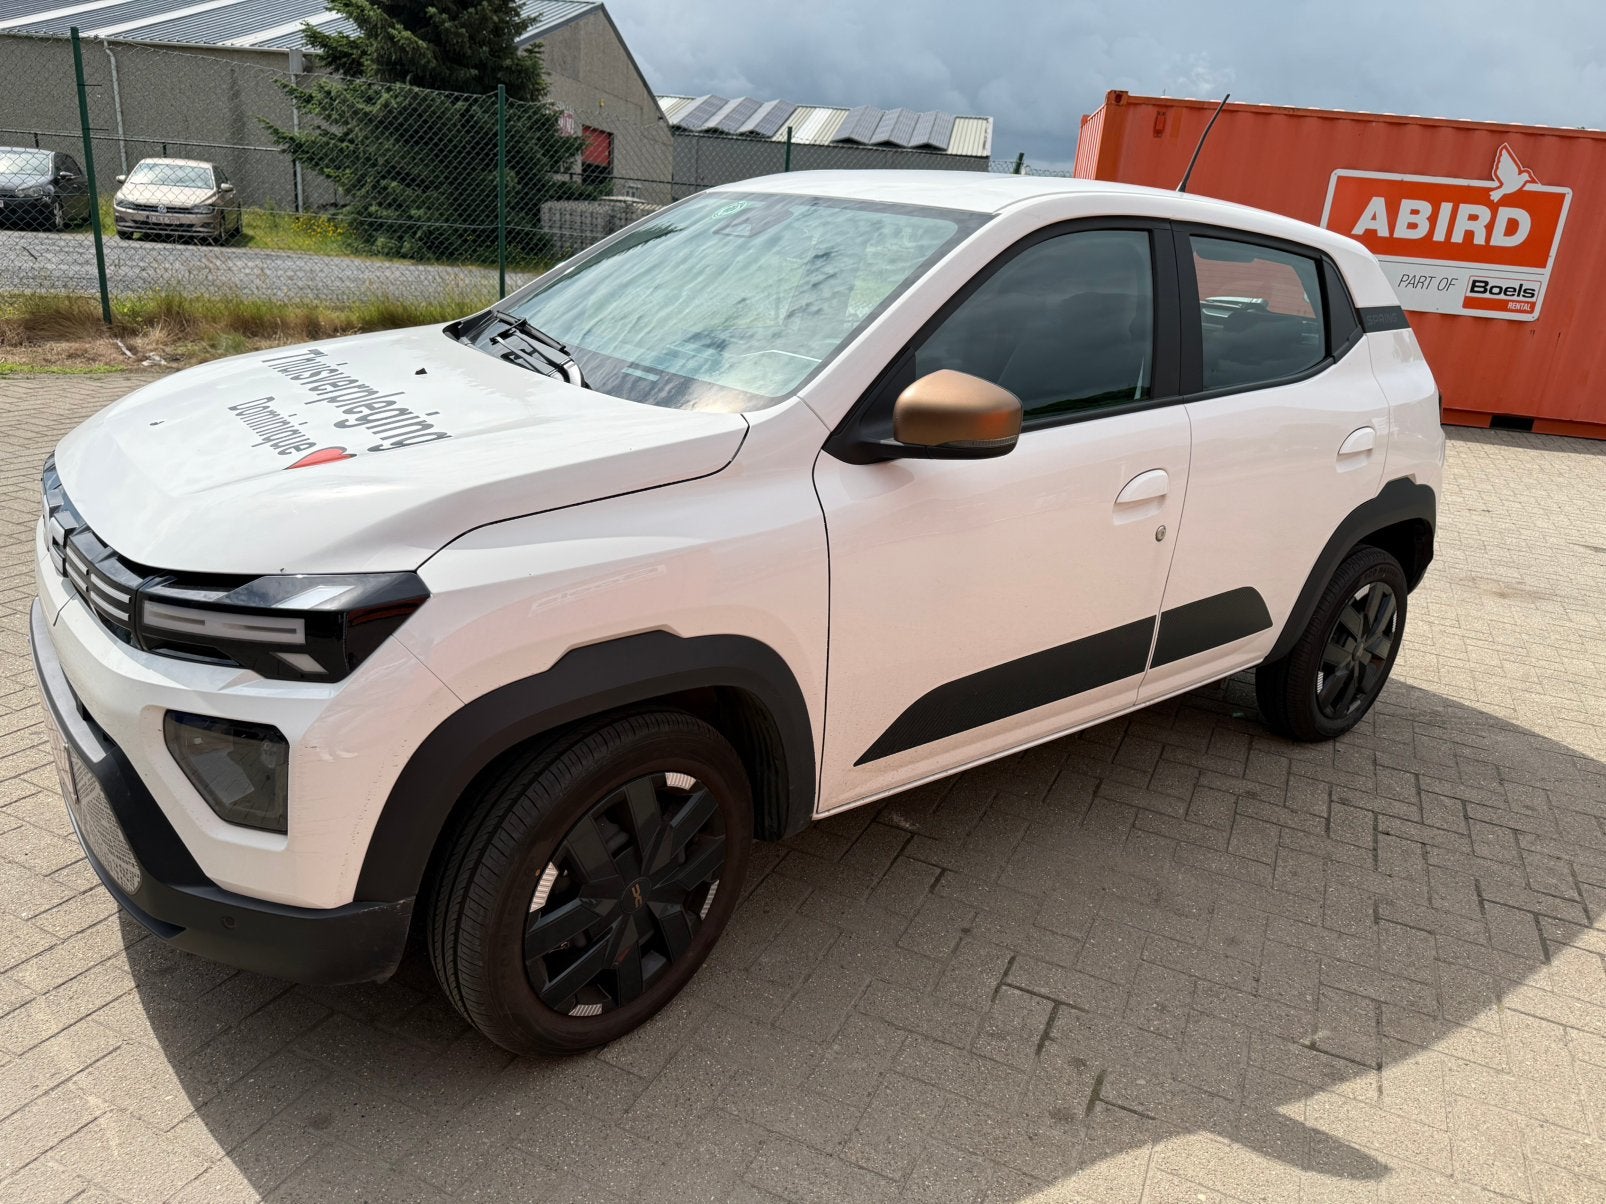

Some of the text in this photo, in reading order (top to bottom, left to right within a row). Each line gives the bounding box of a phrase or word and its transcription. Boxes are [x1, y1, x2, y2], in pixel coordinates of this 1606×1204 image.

[1352, 196, 1531, 247] ABIRD
[1398, 273, 1458, 291] PART OF
[1469, 279, 1536, 299] Boels
[1507, 301, 1532, 311] RENTAL
[1367, 311, 1398, 326] SPRING
[262, 348, 453, 452] Thuisverpleging
[228, 396, 317, 455] Dominique
